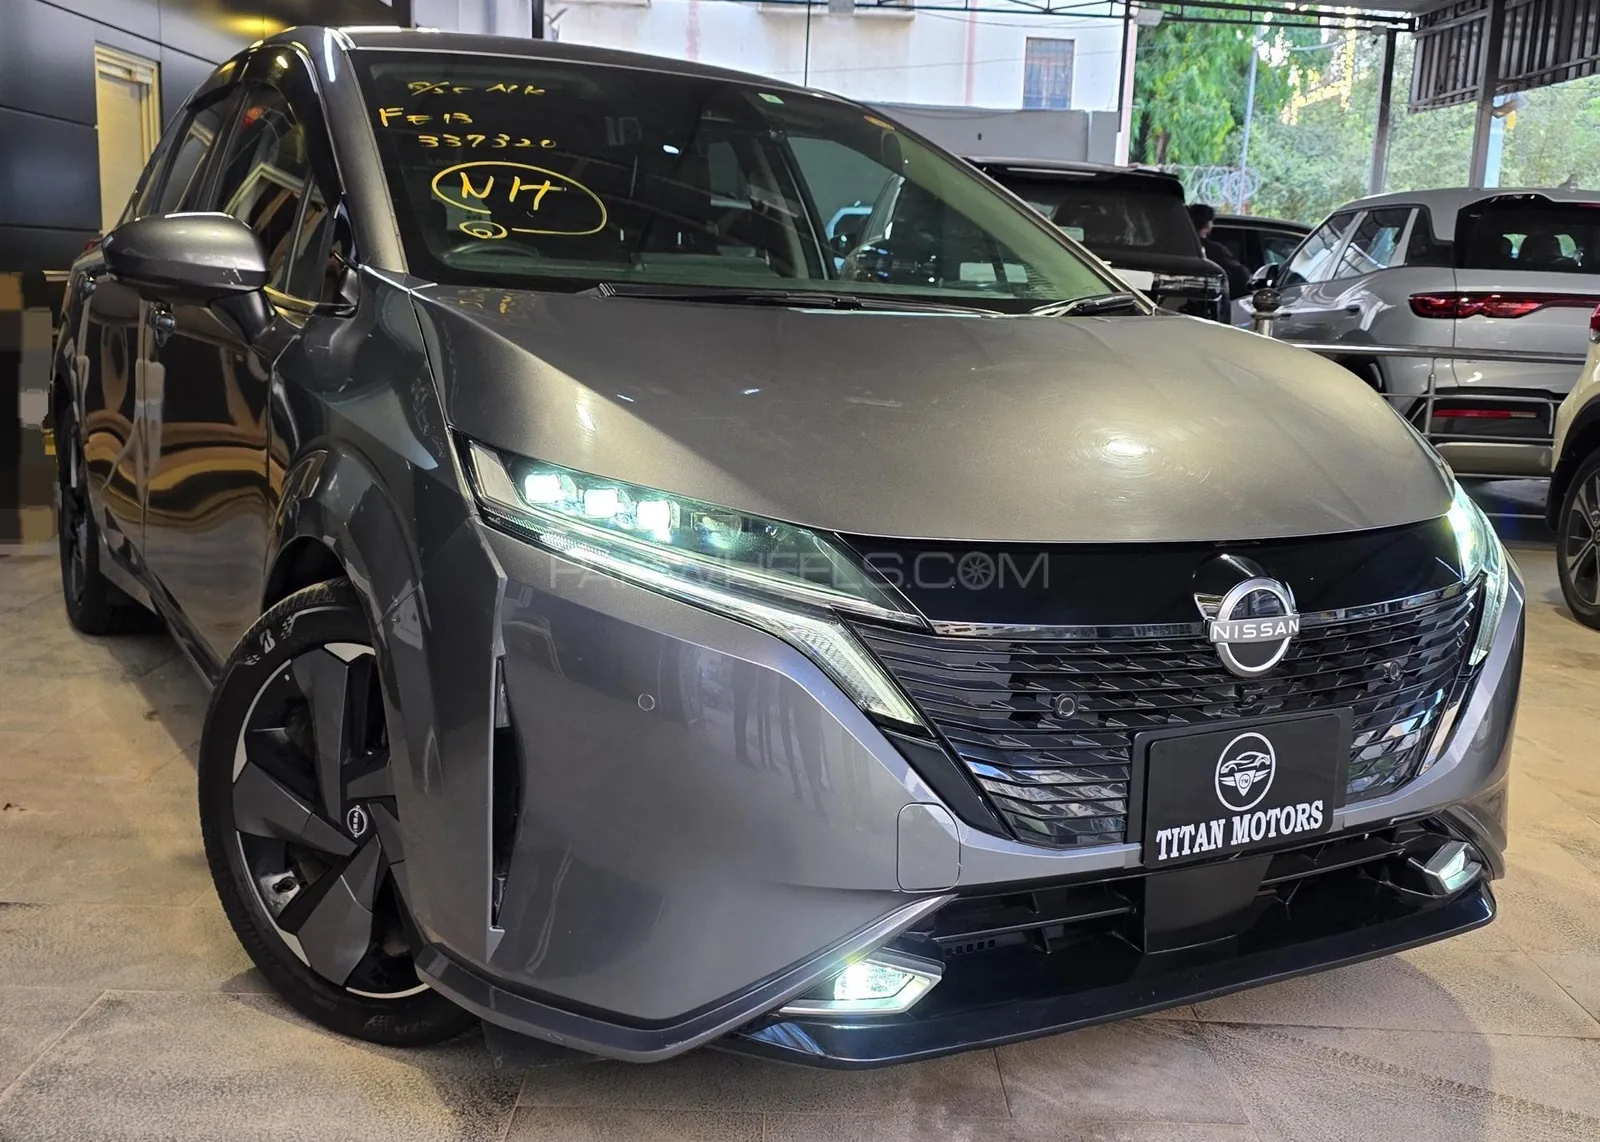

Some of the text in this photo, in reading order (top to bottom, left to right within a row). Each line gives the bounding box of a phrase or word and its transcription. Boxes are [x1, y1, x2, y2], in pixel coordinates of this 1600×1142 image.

[1212, 618, 1299, 640] NISSAN
[1156, 800, 1323, 860] TITAN MOTORS
